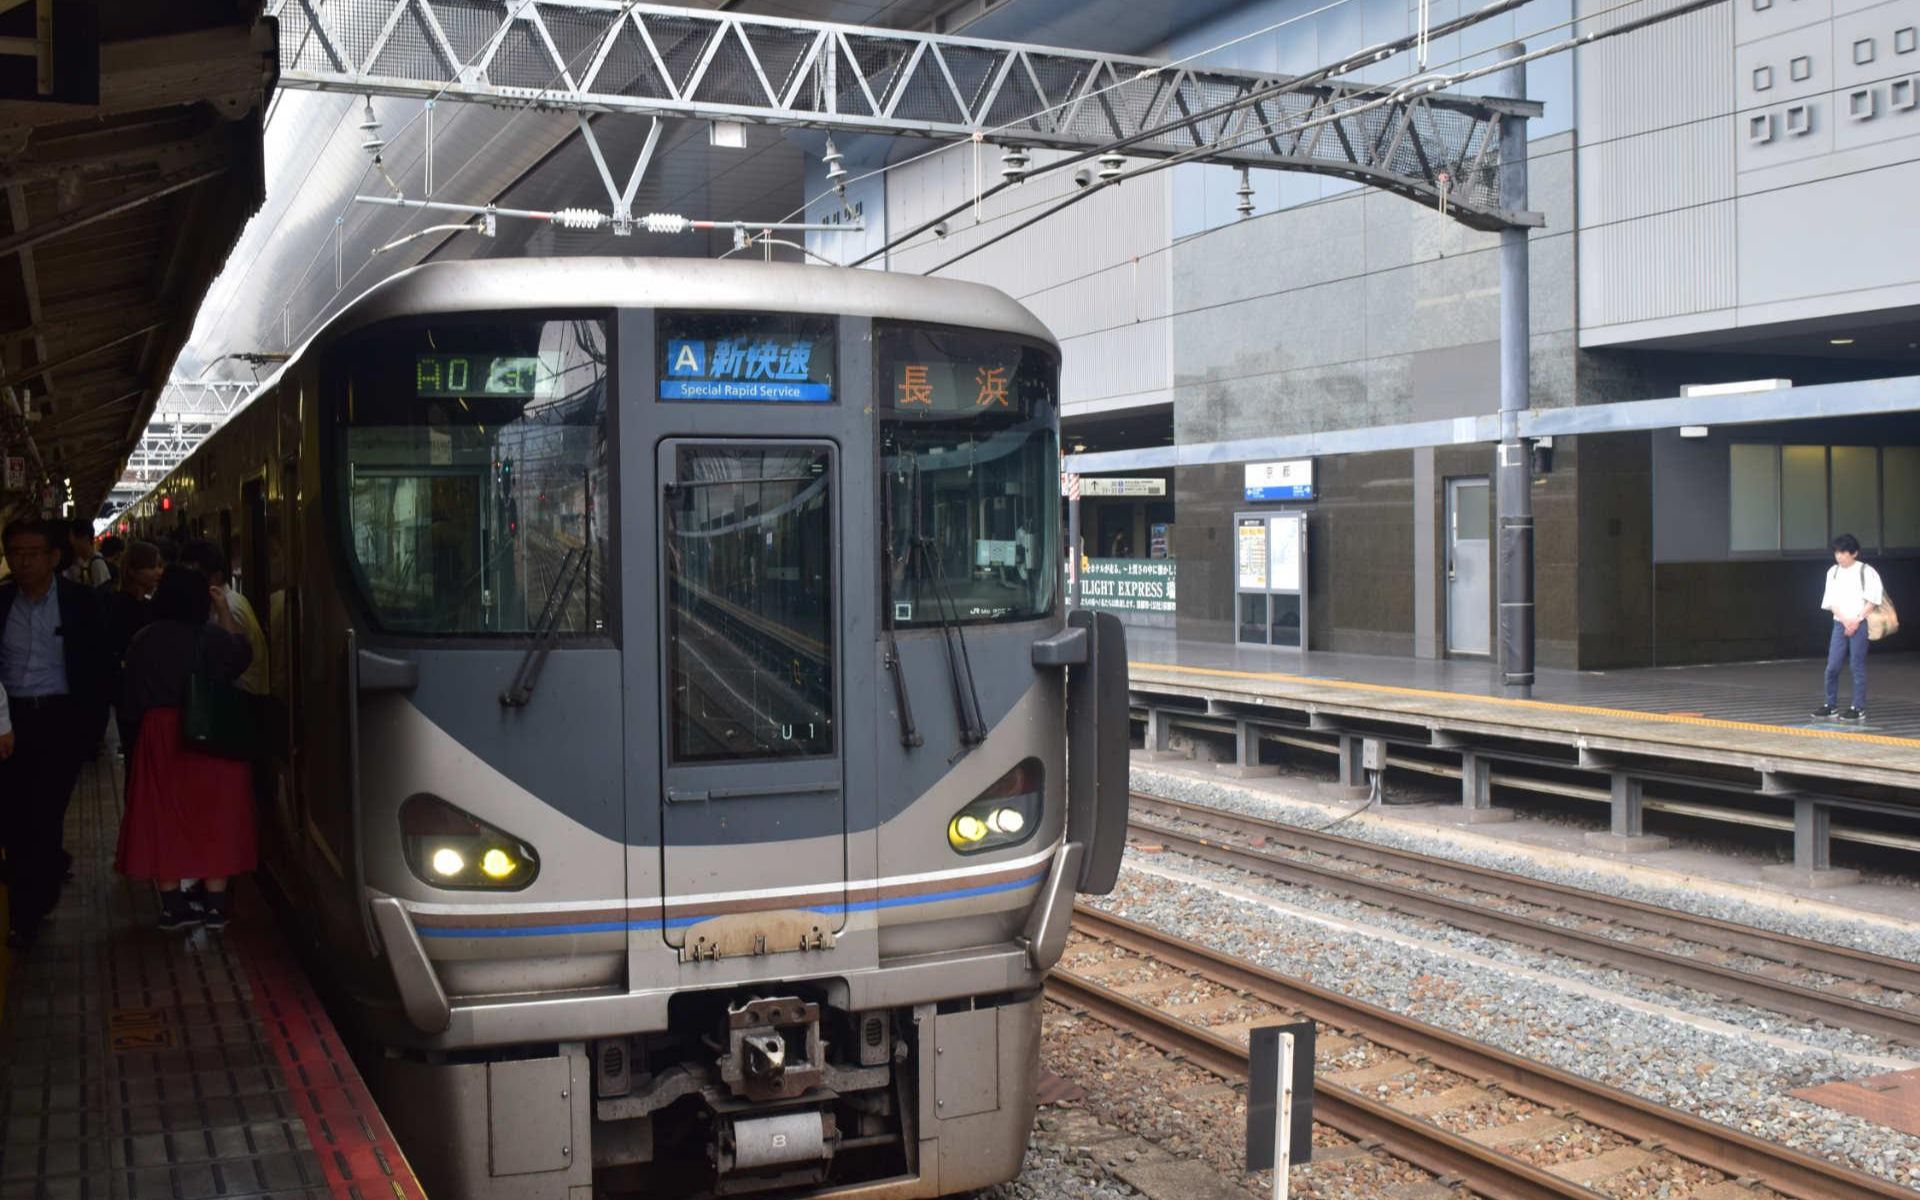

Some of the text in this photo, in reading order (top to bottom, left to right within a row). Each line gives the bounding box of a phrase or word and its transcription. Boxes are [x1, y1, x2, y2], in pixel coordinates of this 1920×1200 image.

[674, 345, 698, 372] A
[709, 336, 812, 380] 新快速
[681, 383, 801, 398] Special Rapid Service
[898, 363, 1009, 407] 長浜
[1066, 580, 1115, 596] TILIGHT
[1118, 581, 1164, 598] EXPRESS
